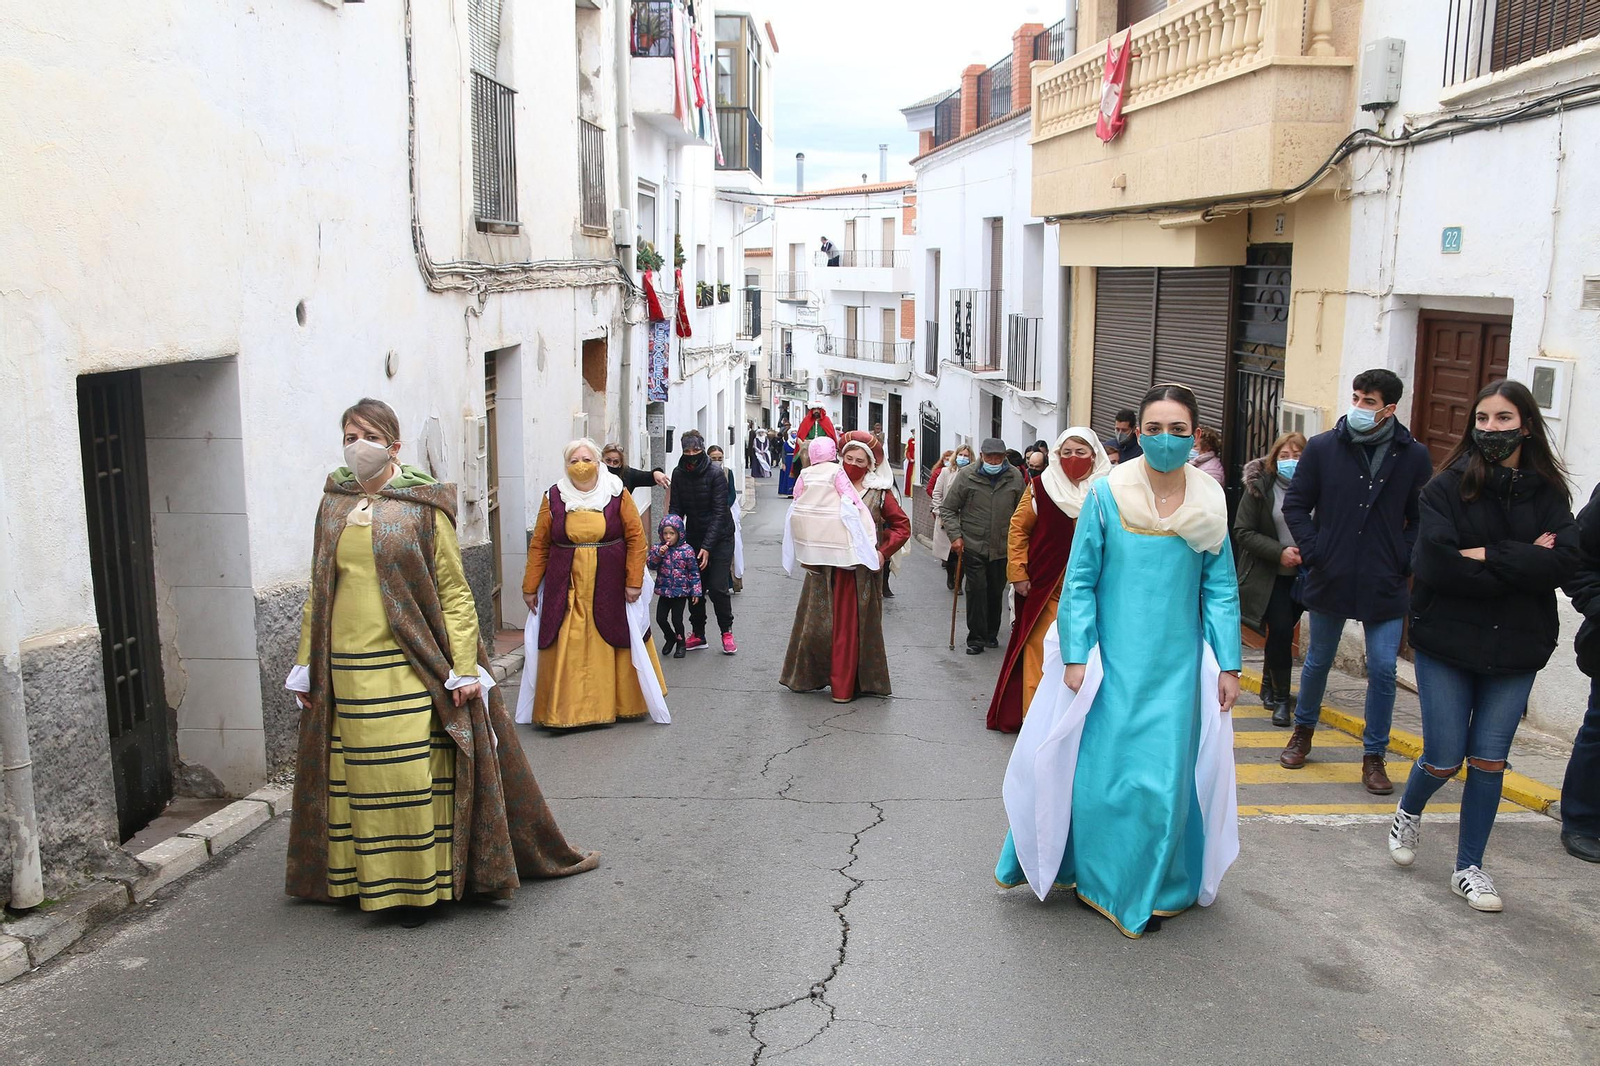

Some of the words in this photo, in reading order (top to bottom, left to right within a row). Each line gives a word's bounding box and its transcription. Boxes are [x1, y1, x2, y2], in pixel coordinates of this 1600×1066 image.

[1275, 218, 1284, 231] 24
[1445, 231, 1458, 248] 22
[652, 322, 666, 394] PESCADERIA
